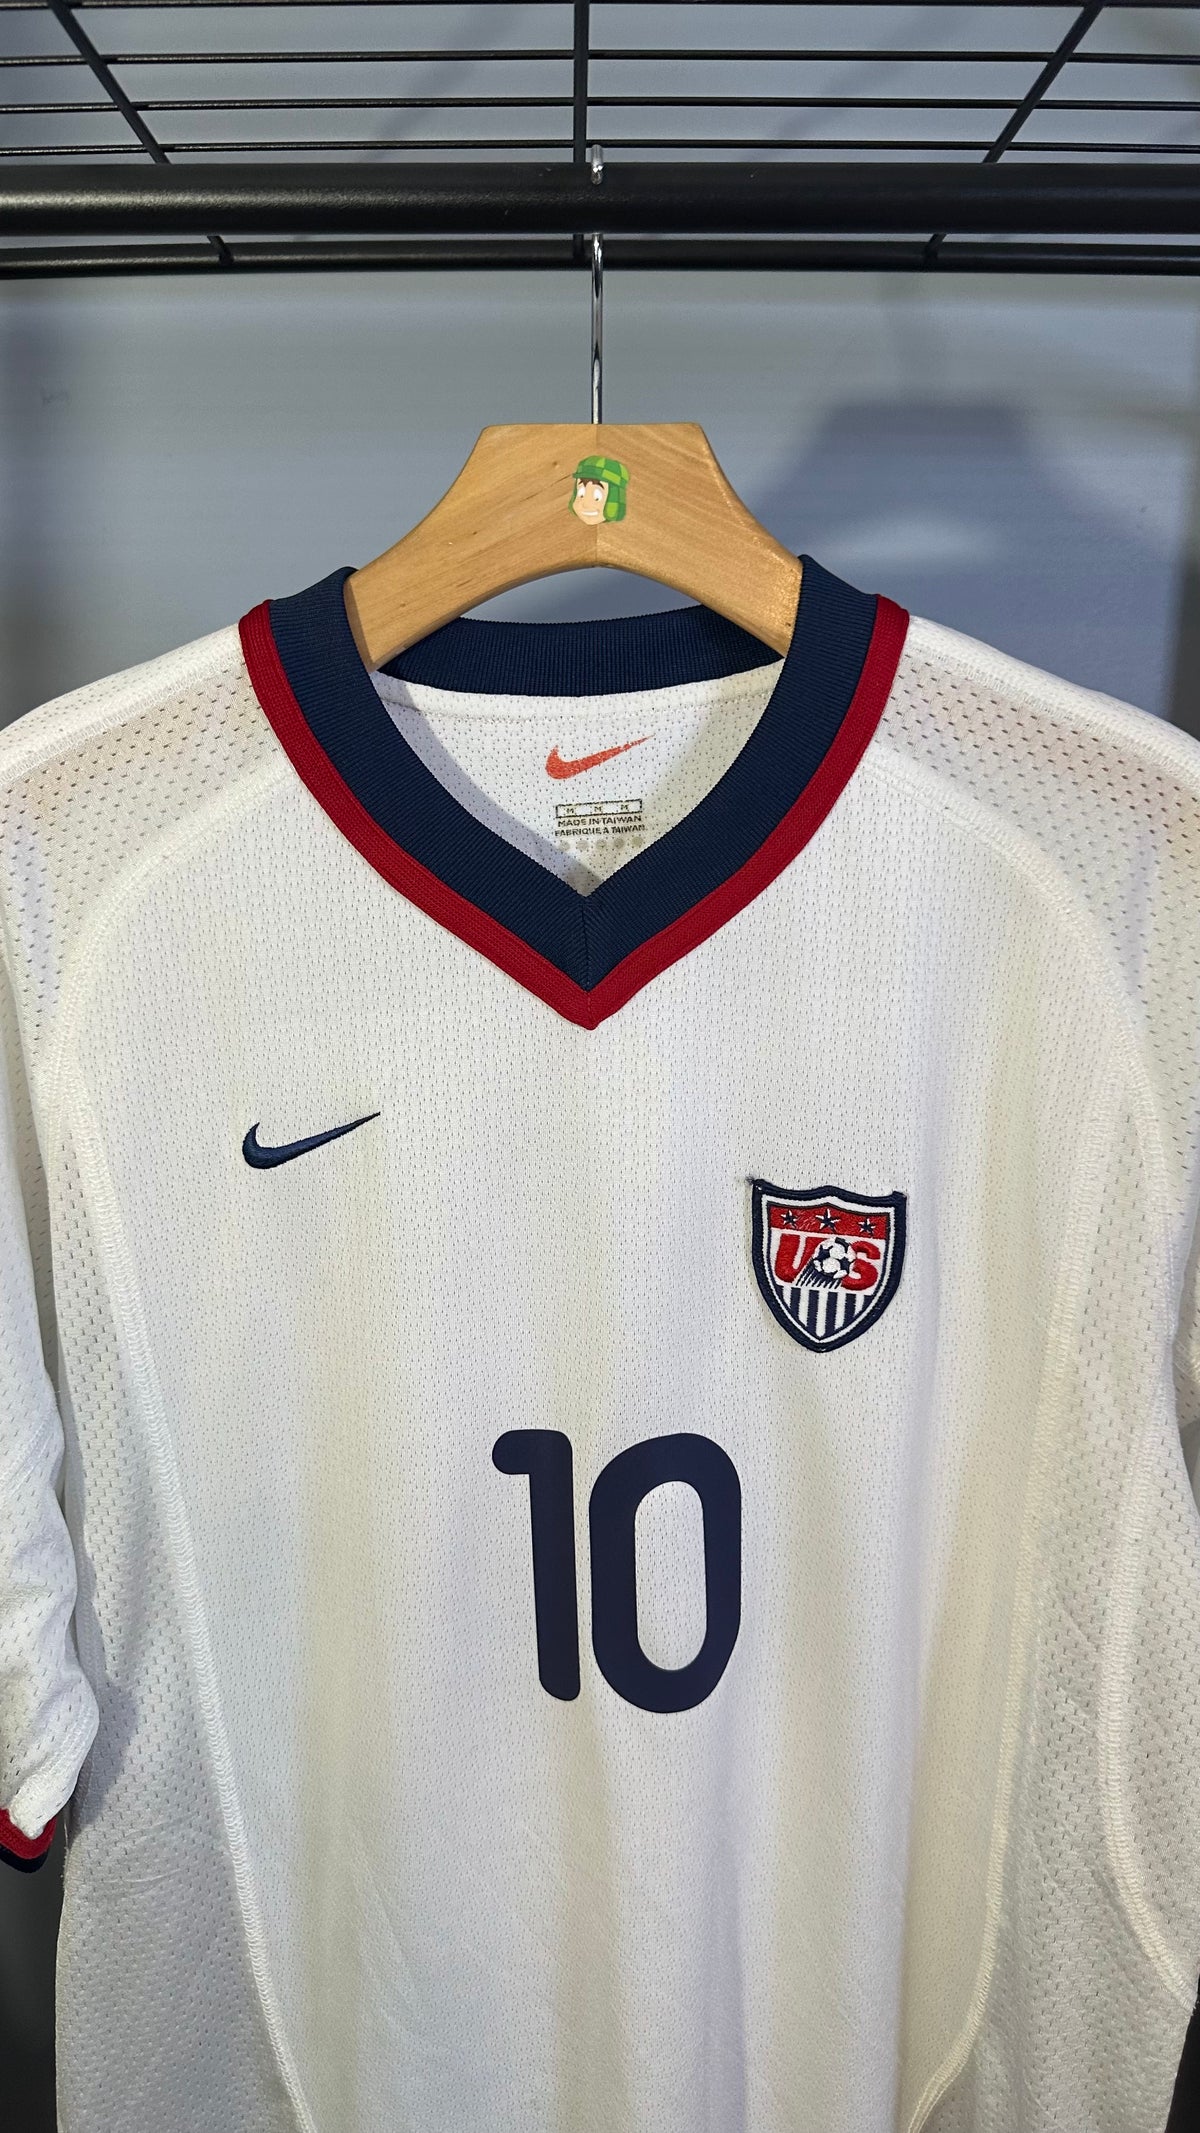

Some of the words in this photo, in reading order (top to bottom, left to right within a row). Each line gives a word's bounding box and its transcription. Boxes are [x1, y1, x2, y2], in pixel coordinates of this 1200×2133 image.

[554, 827, 602, 837] FABRIQUE
[557, 818, 587, 828] MADE
[588, 818, 600, 826] IN
[602, 815, 642, 825] TAIWAN
[774, 1233, 881, 1291] US
[491, 1428, 742, 1714] 10
